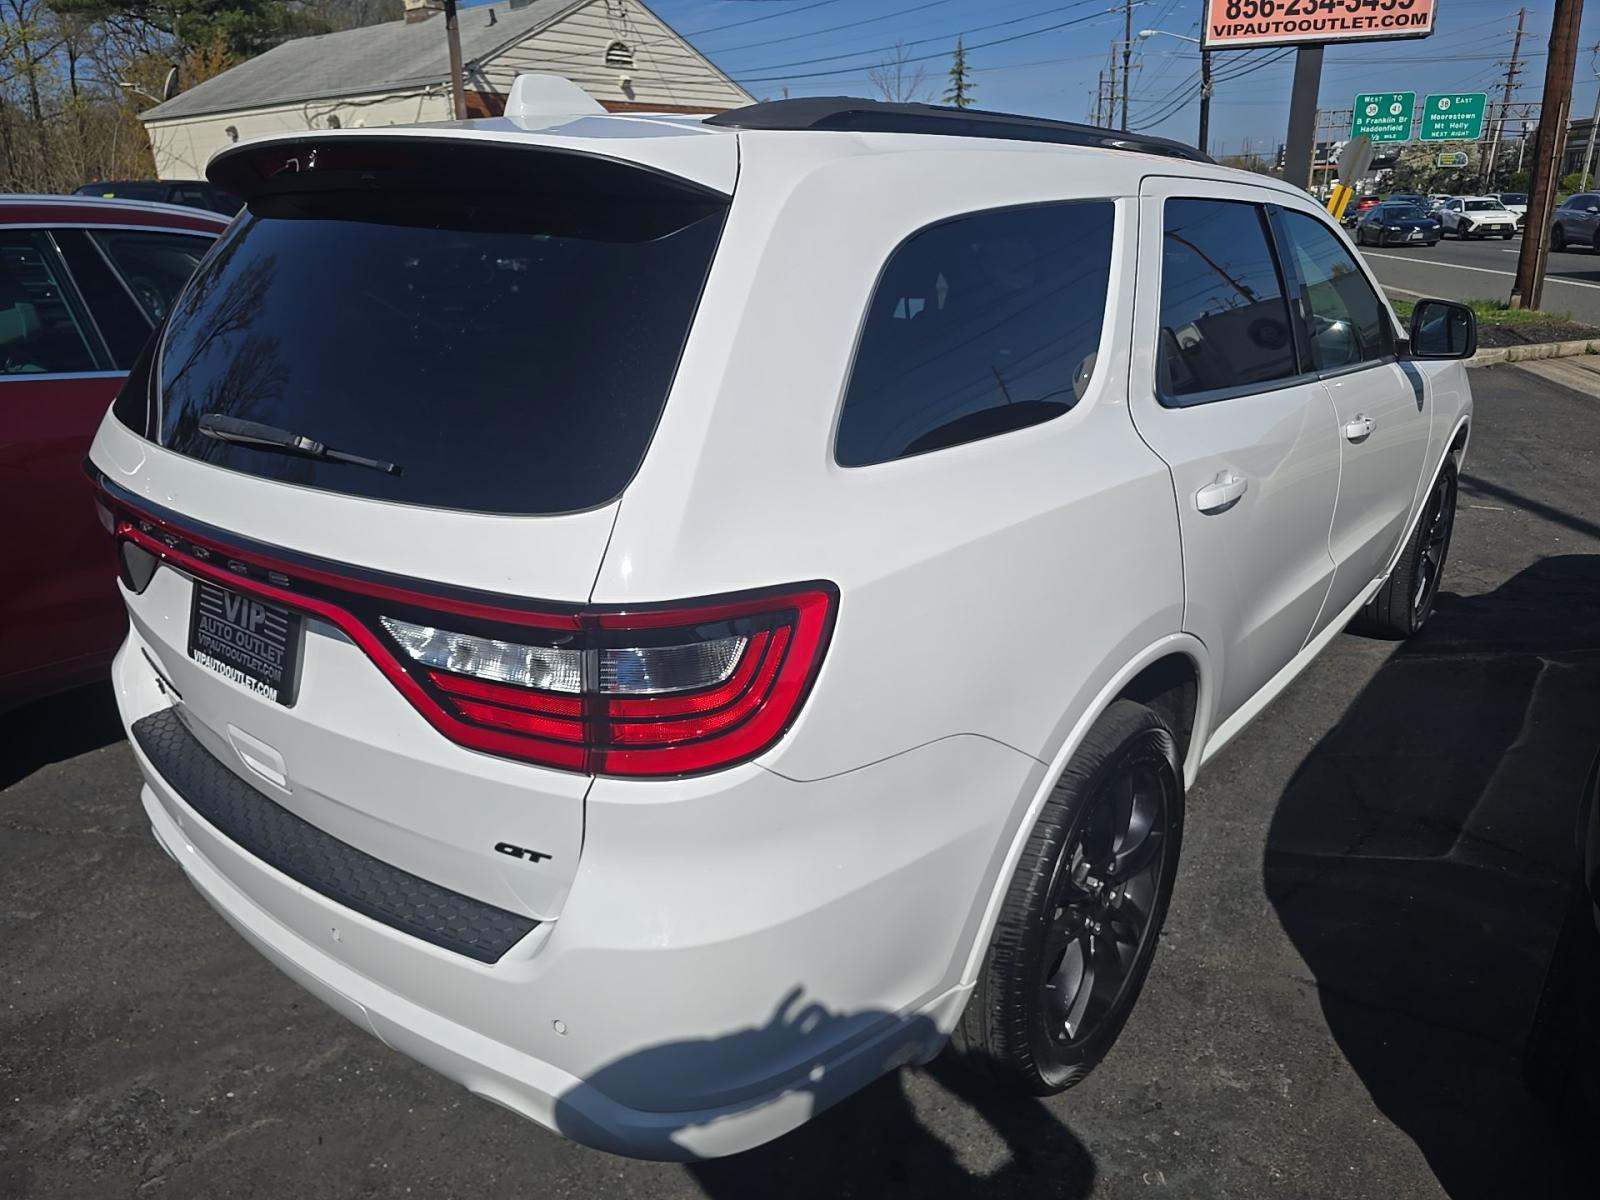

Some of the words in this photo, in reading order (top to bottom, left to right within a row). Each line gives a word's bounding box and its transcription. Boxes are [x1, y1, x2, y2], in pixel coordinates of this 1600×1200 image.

[1213, 12, 1428, 37] VIPAUTOOUTLET.COM
[1360, 125, 1403, 133] Haddonfield
[1365, 116, 1396, 124] Franklin
[1430, 113, 1476, 121] Moorestown
[1449, 122, 1469, 130] Holly
[223, 590, 266, 632] VIP
[200, 615, 233, 642] AUTO
[235, 631, 284, 665] OUTLET
[198, 632, 282, 681] VIPAUTOOUTLET.COM
[193, 649, 278, 702] VIPAUTOOUTLET.COM
[494, 841, 553, 864] GT
